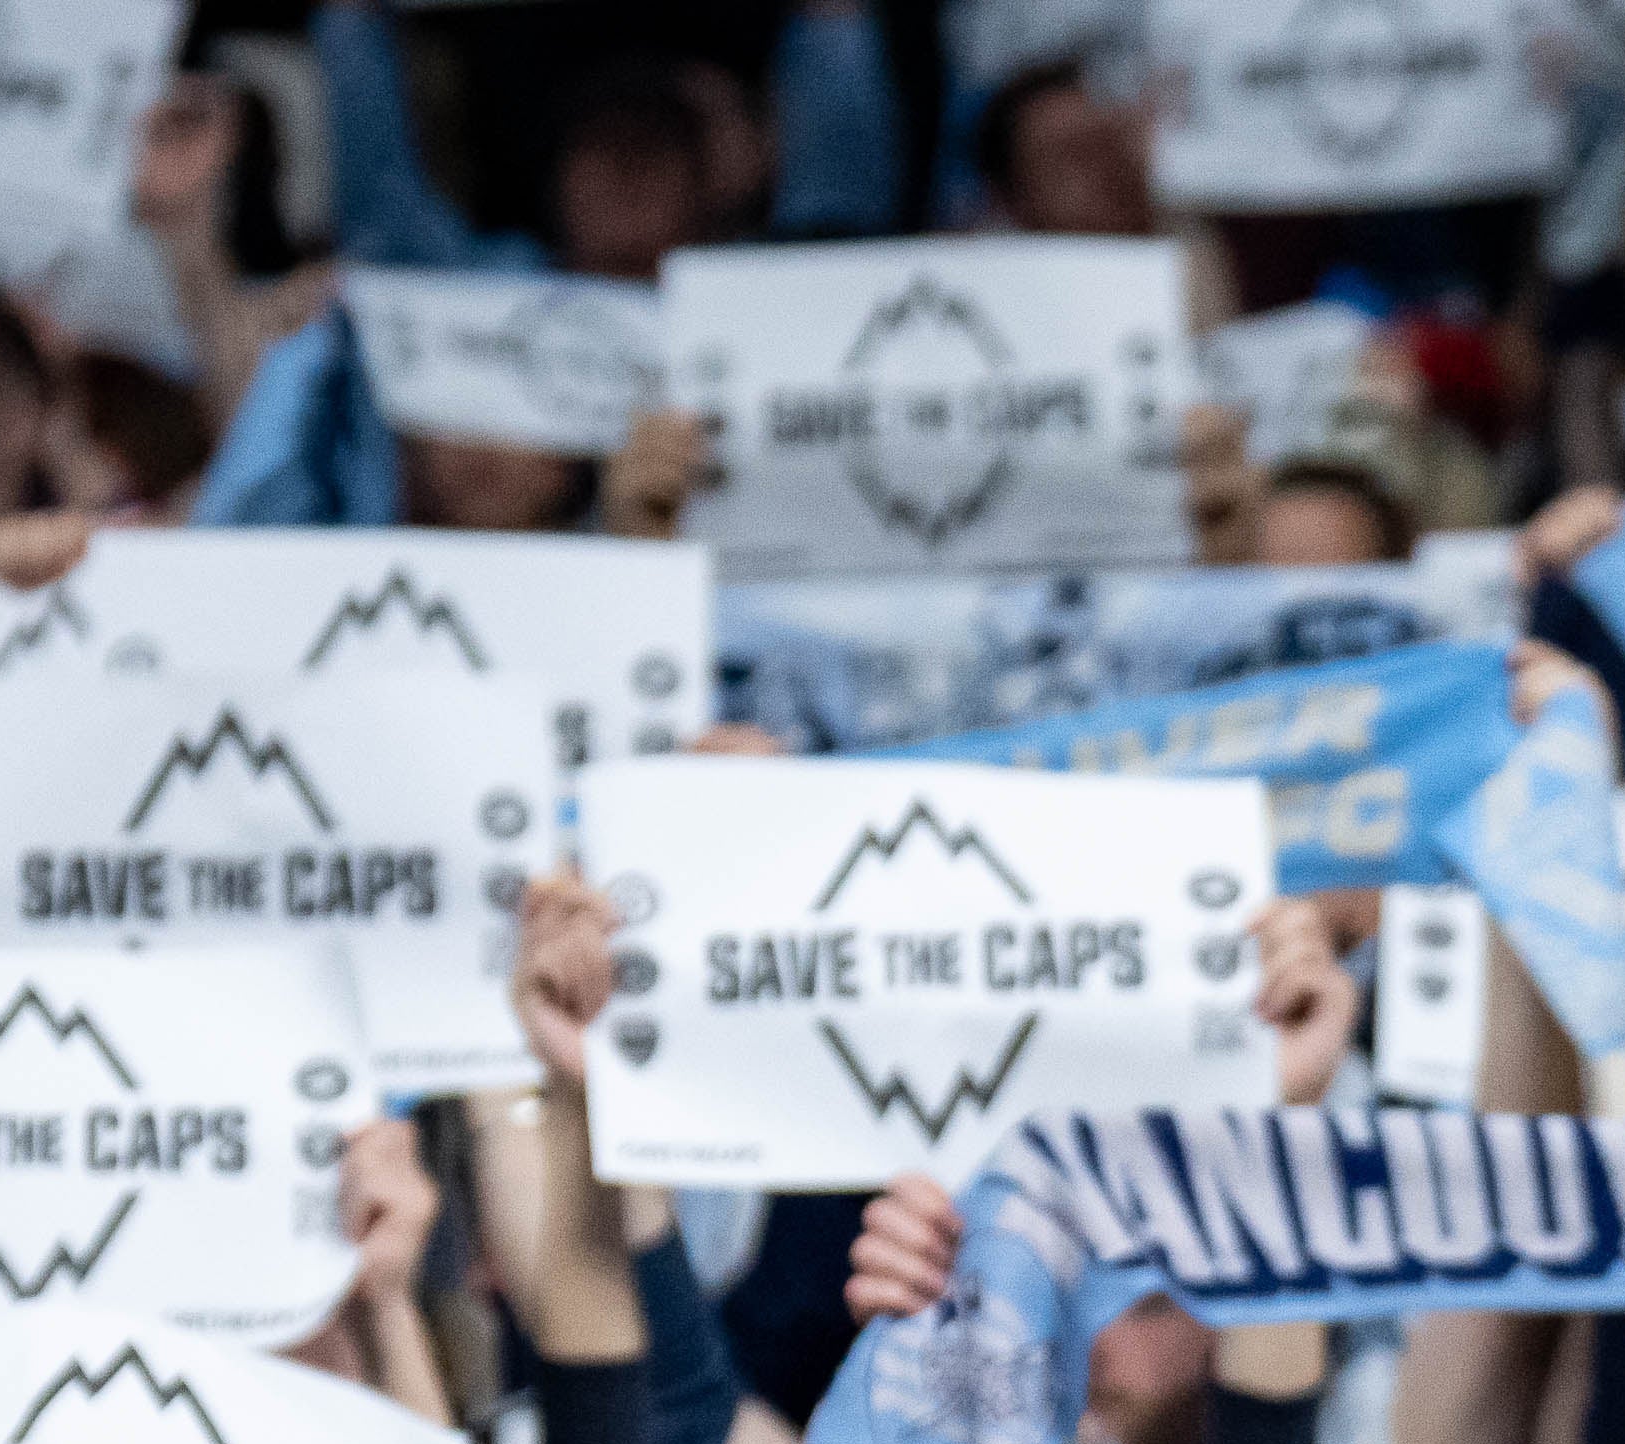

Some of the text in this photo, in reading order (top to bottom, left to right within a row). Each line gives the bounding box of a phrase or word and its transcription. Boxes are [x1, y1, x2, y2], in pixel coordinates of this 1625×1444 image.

[20, 849, 439, 920] SAVE THE CAPS
[707, 922, 1145, 1003] SAVE THE CAPS
[85, 1108, 250, 1175] CAPS
